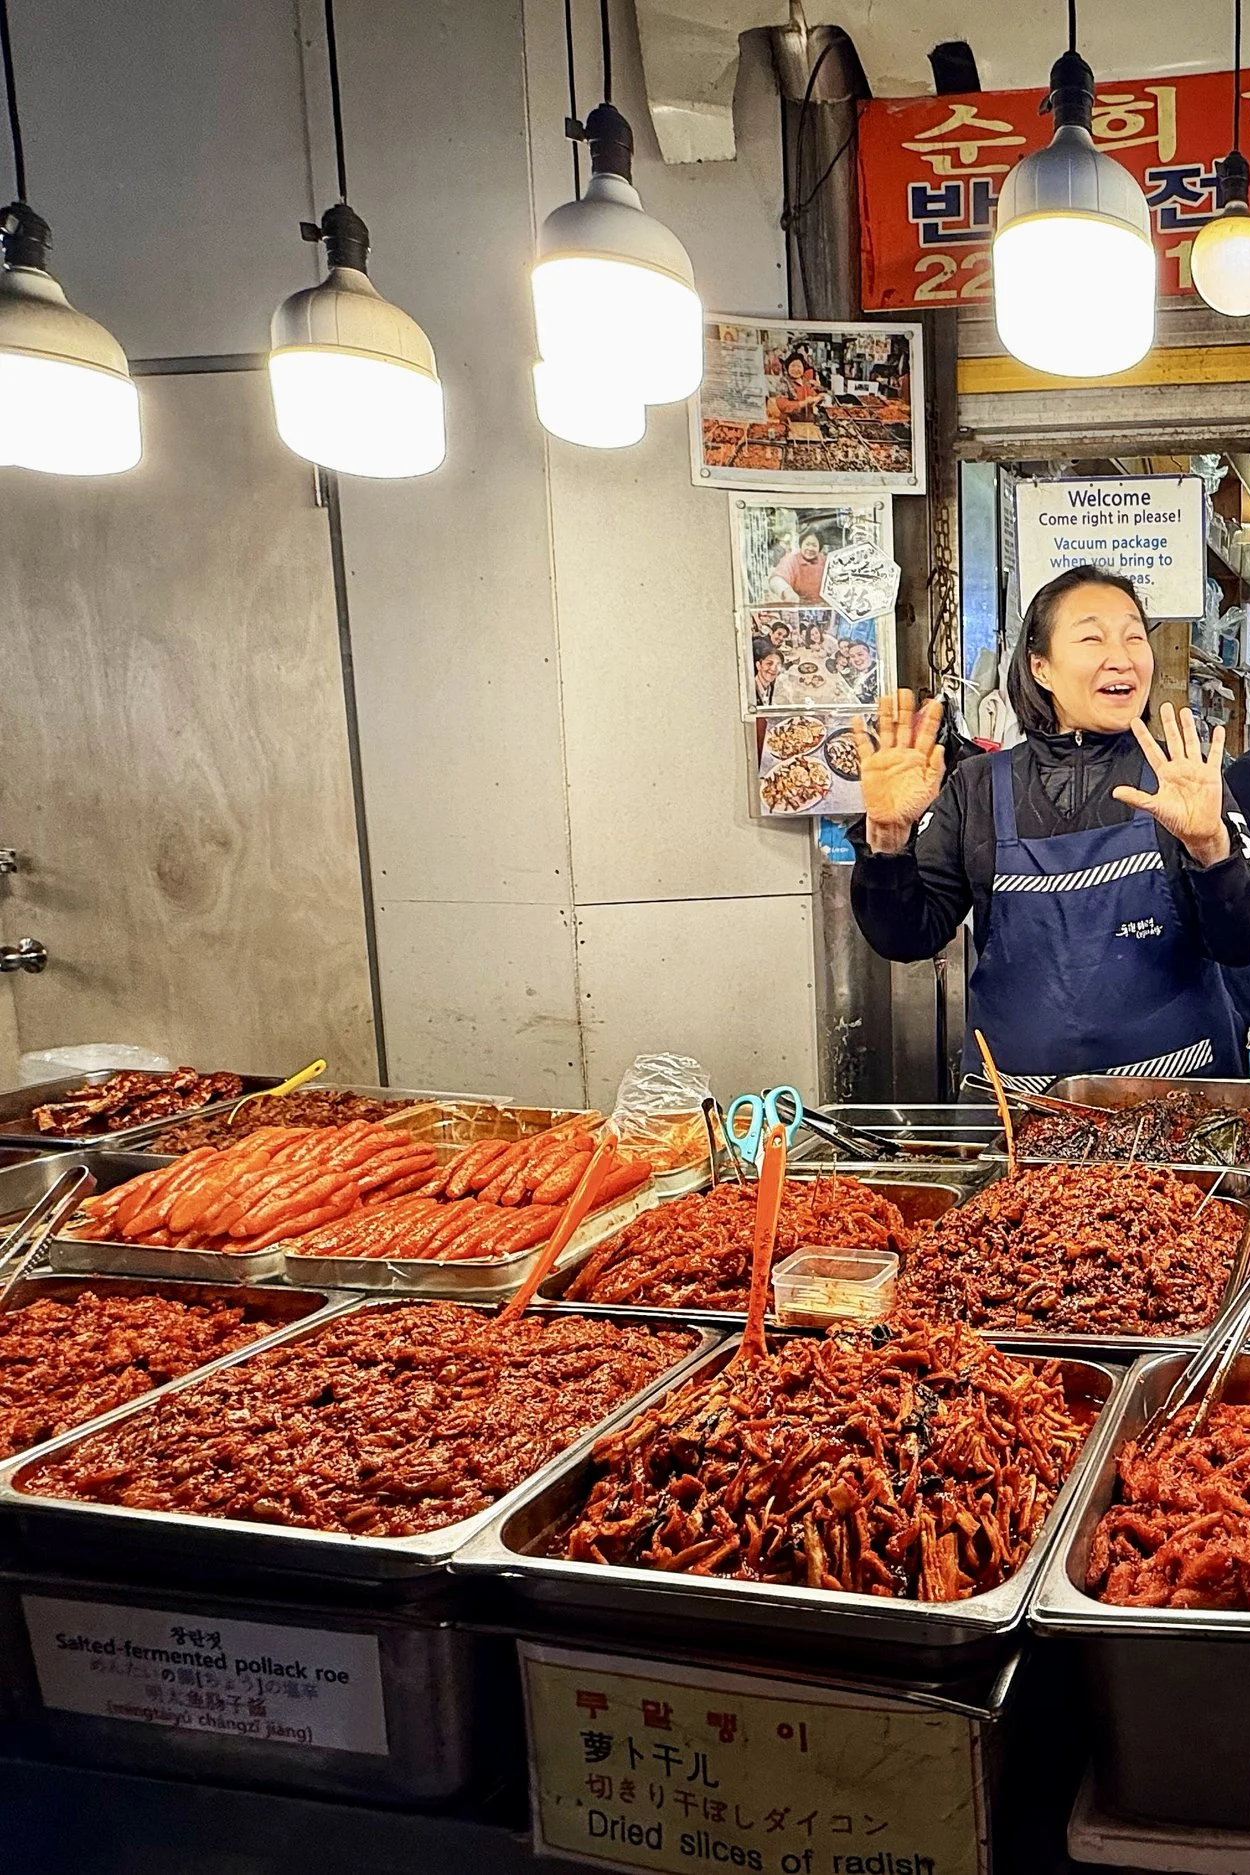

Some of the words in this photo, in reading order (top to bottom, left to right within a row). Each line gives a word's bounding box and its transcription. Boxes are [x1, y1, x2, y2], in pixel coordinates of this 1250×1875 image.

[1068, 489, 1151, 507] Welcome
[1039, 512, 1078, 526] Come
[1082, 511, 1114, 527] right
[1117, 510, 1129, 524] in
[1133, 509, 1182, 526] please!
[1053, 537, 1107, 551] Vacuum
[1112, 535, 1168, 551] package
[1050, 554, 1087, 569] when
[1091, 556, 1116, 569] you
[1119, 553, 1154, 569] bring
[1158, 553, 1173, 566] to
[169, 1626, 222, 1650] 창란젓
[56, 1632, 227, 1670] Salted-fermented
[235, 1657, 308, 1681] pollack
[315, 1666, 349, 1684] roe
[581, 1730, 720, 1789] 萝卜干儿
[588, 1811, 663, 1851] Dried
[680, 1834, 764, 1870] slices
[781, 1851, 813, 1874] of
[833, 1851, 936, 1875] radish
